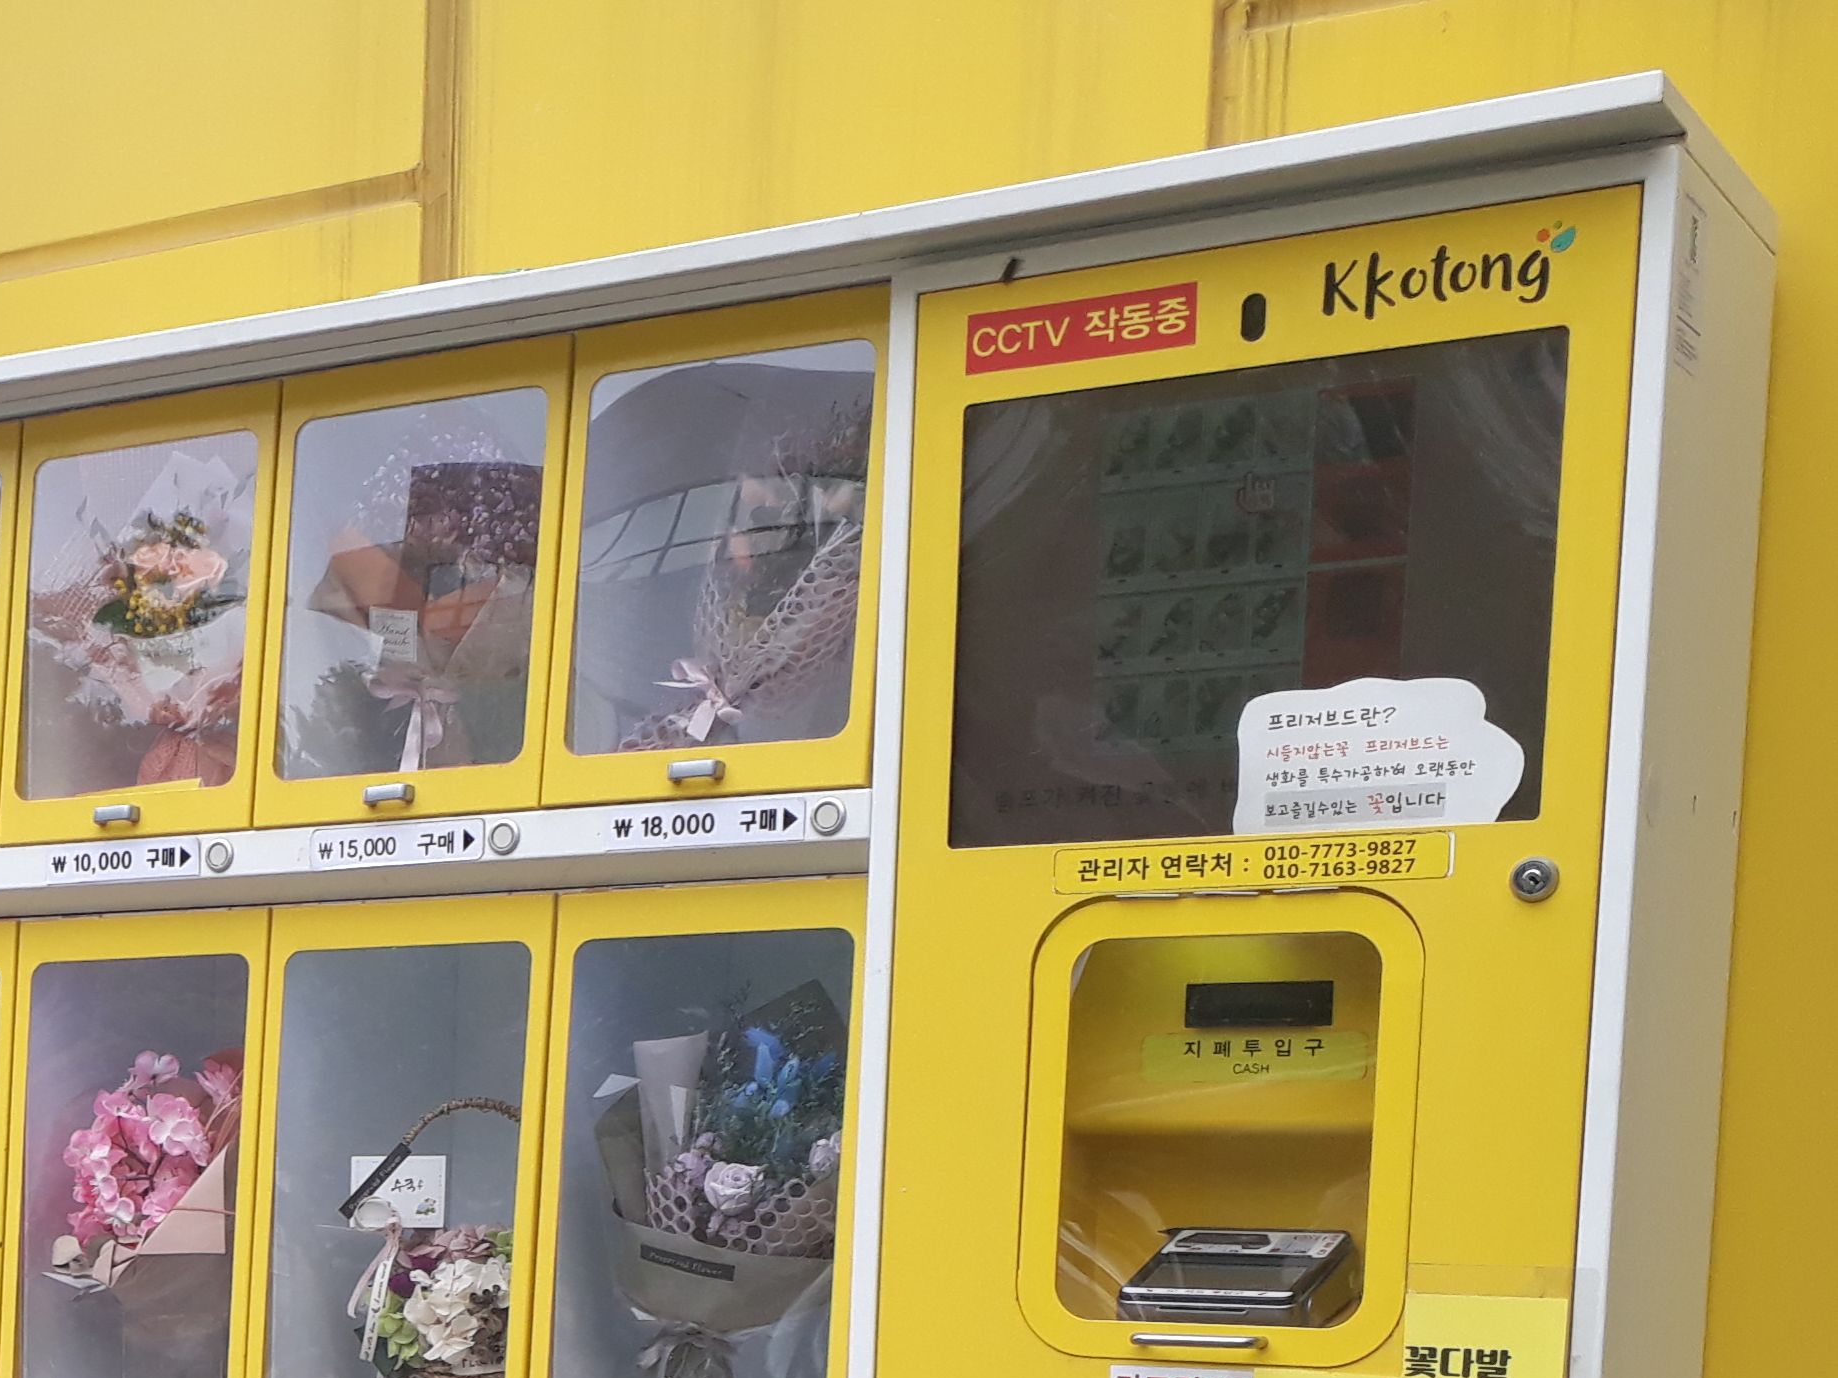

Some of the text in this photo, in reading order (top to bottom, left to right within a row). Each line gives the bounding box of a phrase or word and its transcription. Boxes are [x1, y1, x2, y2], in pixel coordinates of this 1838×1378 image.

[1322, 244, 1550, 319] Kkotong
[972, 295, 1188, 358] CCTV 작동중
[1268, 707, 1396, 731] 프리저브드란?
[1365, 735, 1450, 754] 프리저브드는
[1266, 768, 1310, 788] 생화를
[1414, 759, 1476, 777] 오랫동안
[1367, 791, 1446, 816] 꽃입니다
[613, 809, 778, 839] ₩ 18,000 구매
[318, 831, 455, 860] ₩ 15,000 구매
[52, 847, 176, 873] ₩ 10,000 구매
[1077, 857, 1150, 882] 관리자
[1161, 853, 1232, 878] 연락처
[1264, 840, 1417, 862] 010-7773-9827
[1263, 859, 1416, 880] 010-7163-9827
[1232, 1063, 1270, 1075] CASH
